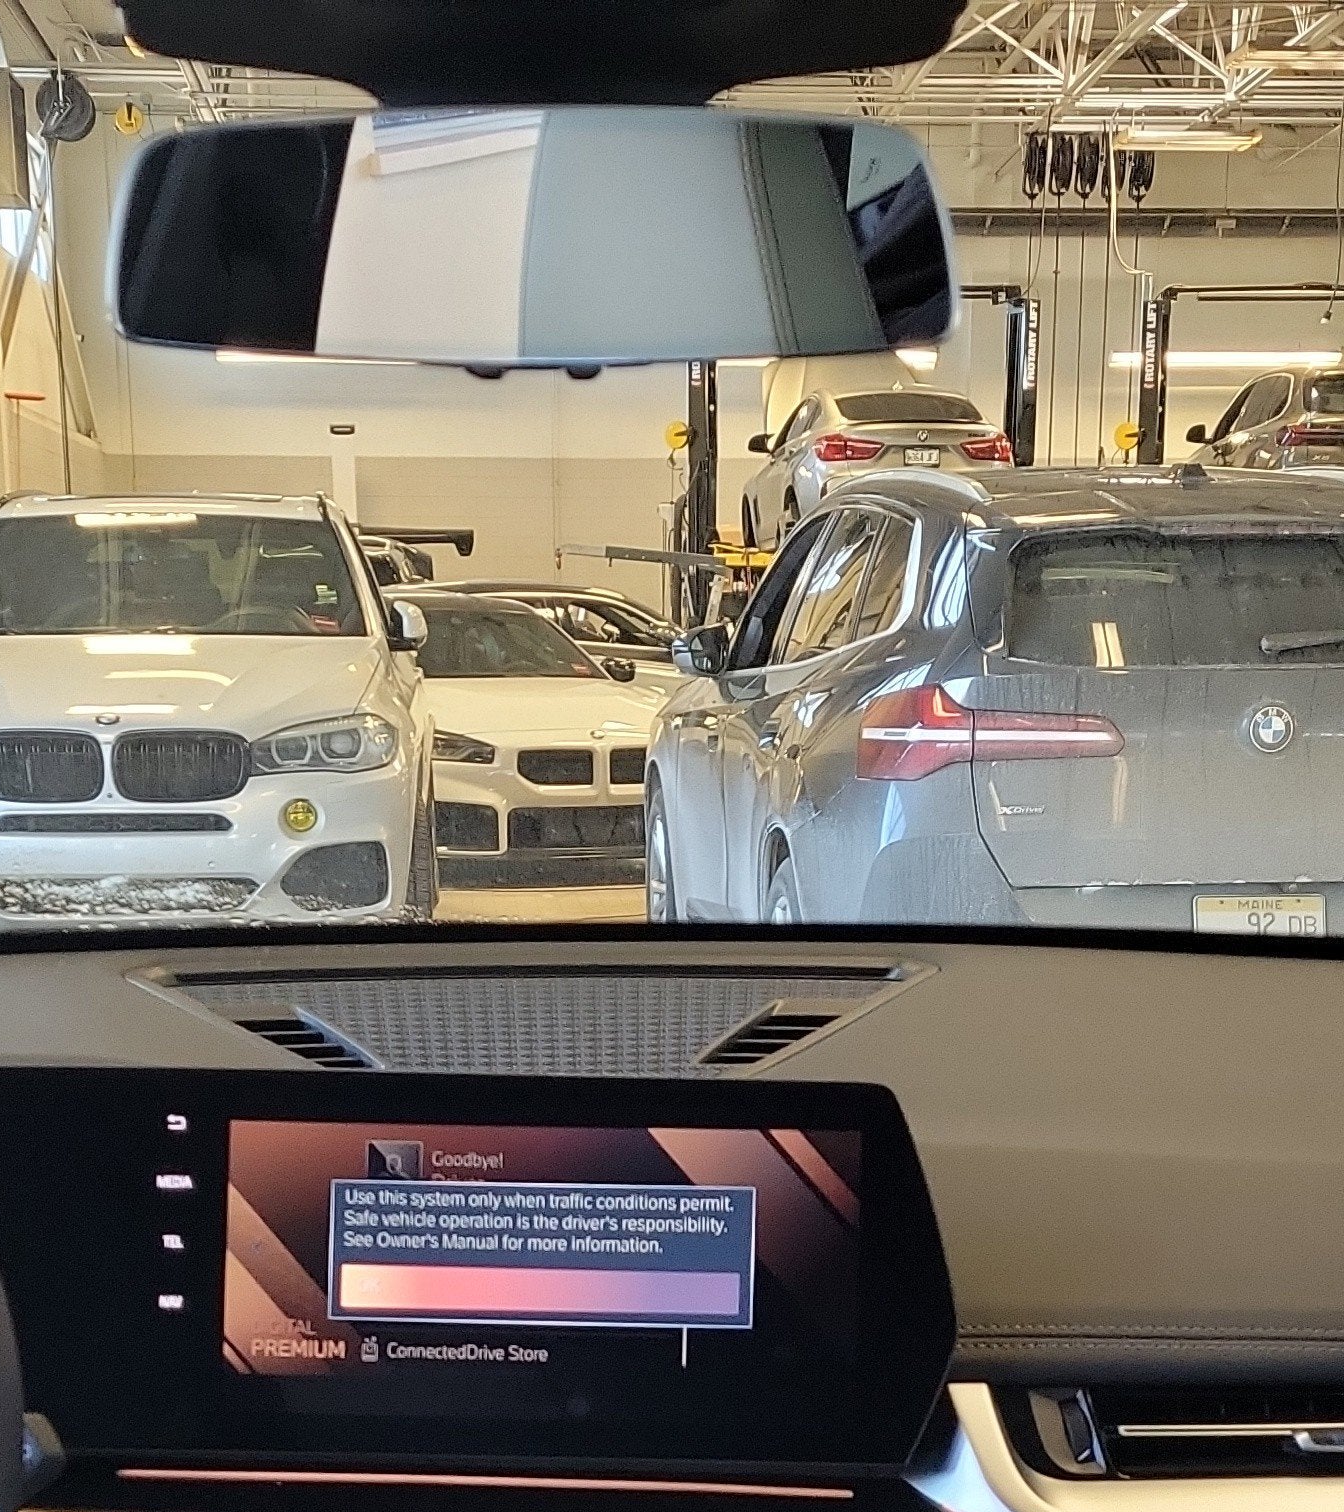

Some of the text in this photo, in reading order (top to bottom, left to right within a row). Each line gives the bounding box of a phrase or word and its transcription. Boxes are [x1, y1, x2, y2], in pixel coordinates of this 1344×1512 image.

[1144, 300, 1157, 382] ROTARY LIFT
[1237, 899, 1284, 910] MAINE
[1247, 912, 1276, 935] 92
[431, 1150, 504, 1171] Goodbye!
[344, 1188, 735, 1214] Use this system only when traffic conditions permit.
[343, 1209, 729, 1237] Safe vehicle operation is the driver's responsibility.
[343, 1230, 664, 1254] See Owner's Manual for more information.
[250, 1338, 346, 1360] PREMIUM
[386, 1342, 549, 1363] ConnectedDrive Store
